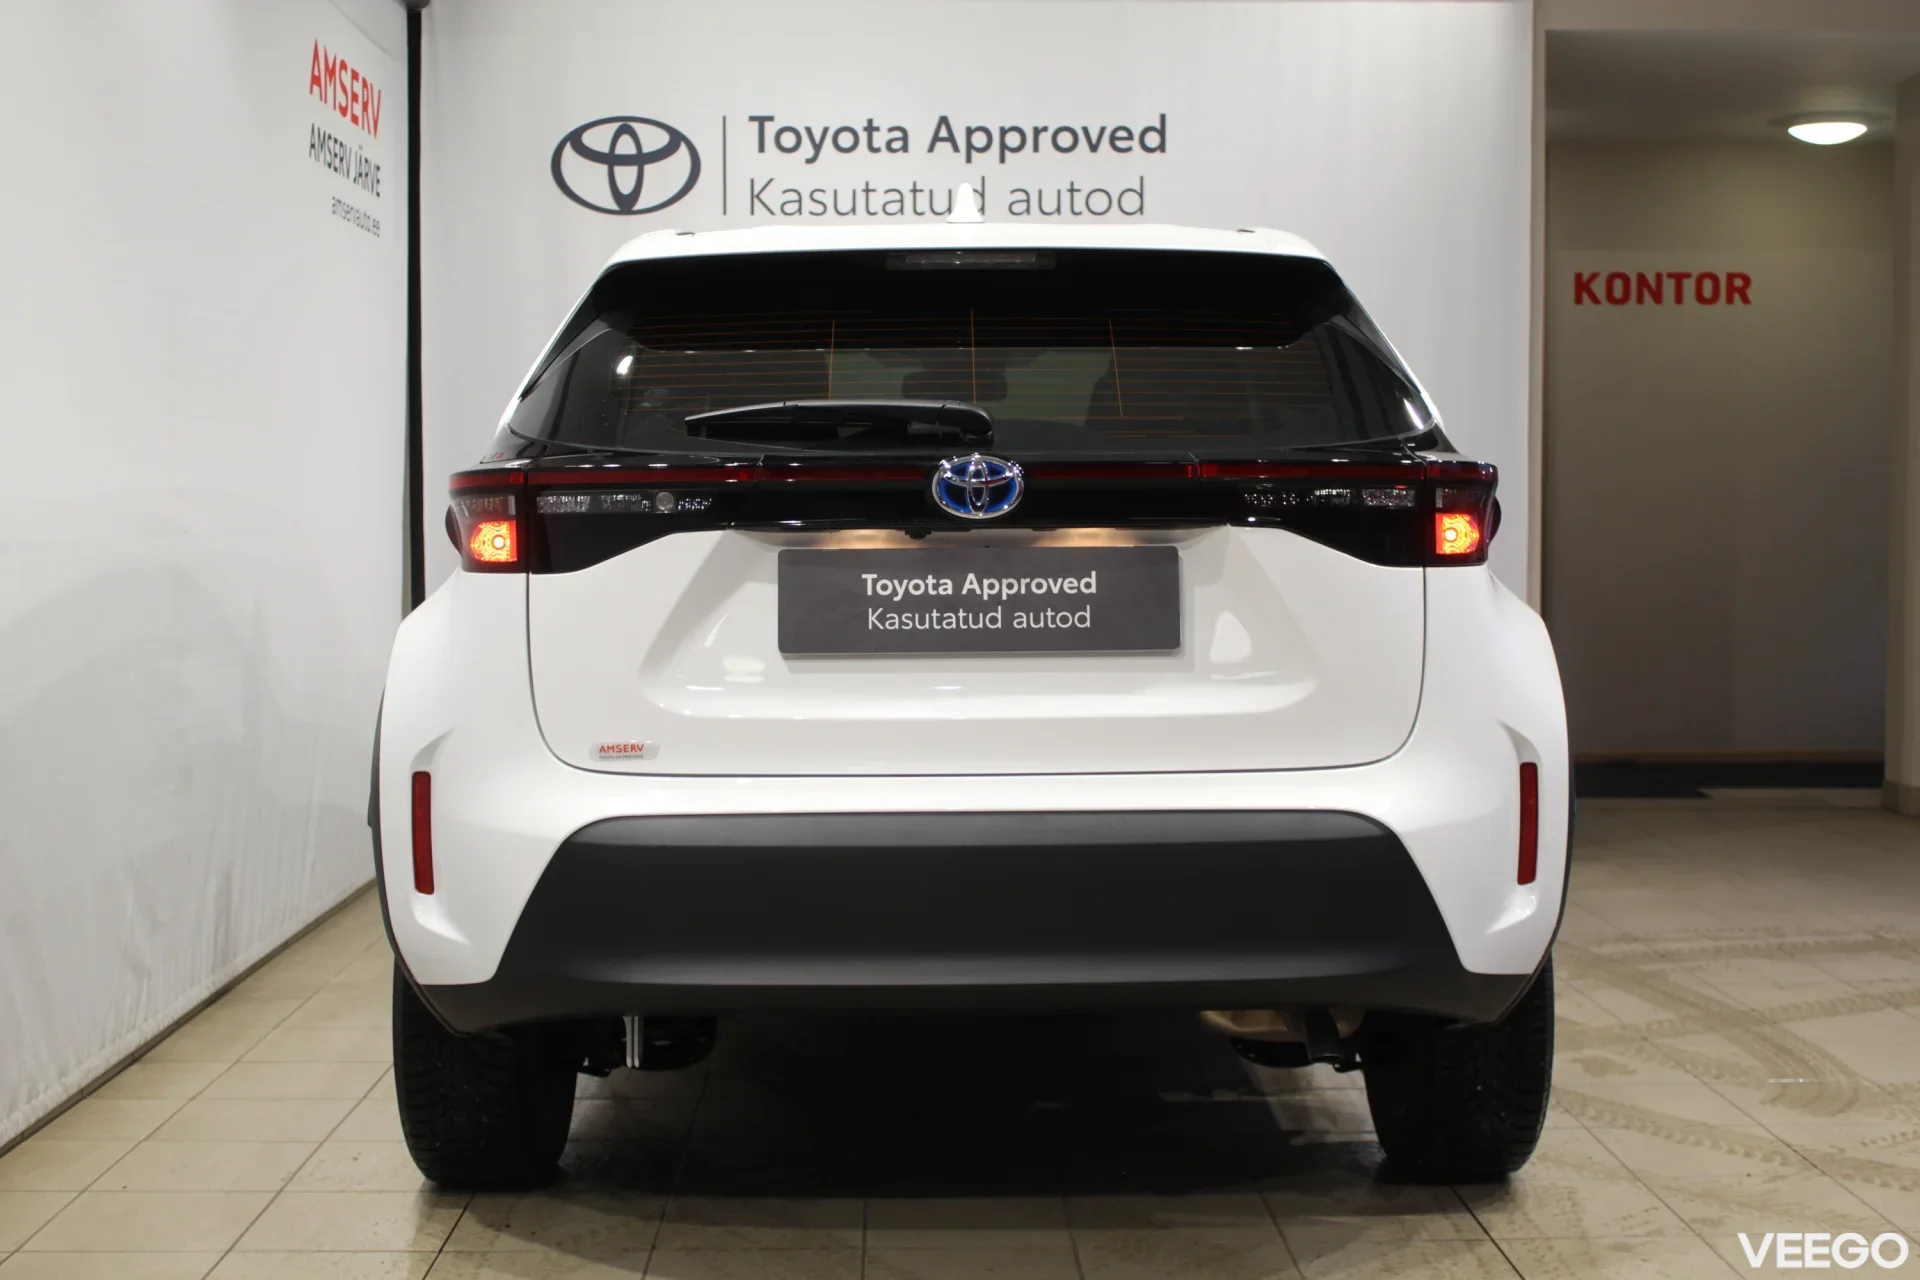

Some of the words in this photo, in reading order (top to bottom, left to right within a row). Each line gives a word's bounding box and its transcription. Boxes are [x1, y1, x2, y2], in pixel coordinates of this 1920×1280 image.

[309, 37, 382, 140] AMSERV
[748, 115, 910, 163] Toyota
[927, 113, 1168, 163] Approved
[308, 122, 353, 181] AMSERV
[353, 144, 381, 199] JÄRVE
[1008, 176, 1145, 216] autod
[1573, 271, 1752, 305] KONTOR
[861, 573, 953, 601] Toyota
[961, 571, 1097, 600] Approved
[868, 606, 1002, 630] Kasutatud
[1013, 605, 1091, 629] autod
[599, 743, 645, 754] AMSERV
